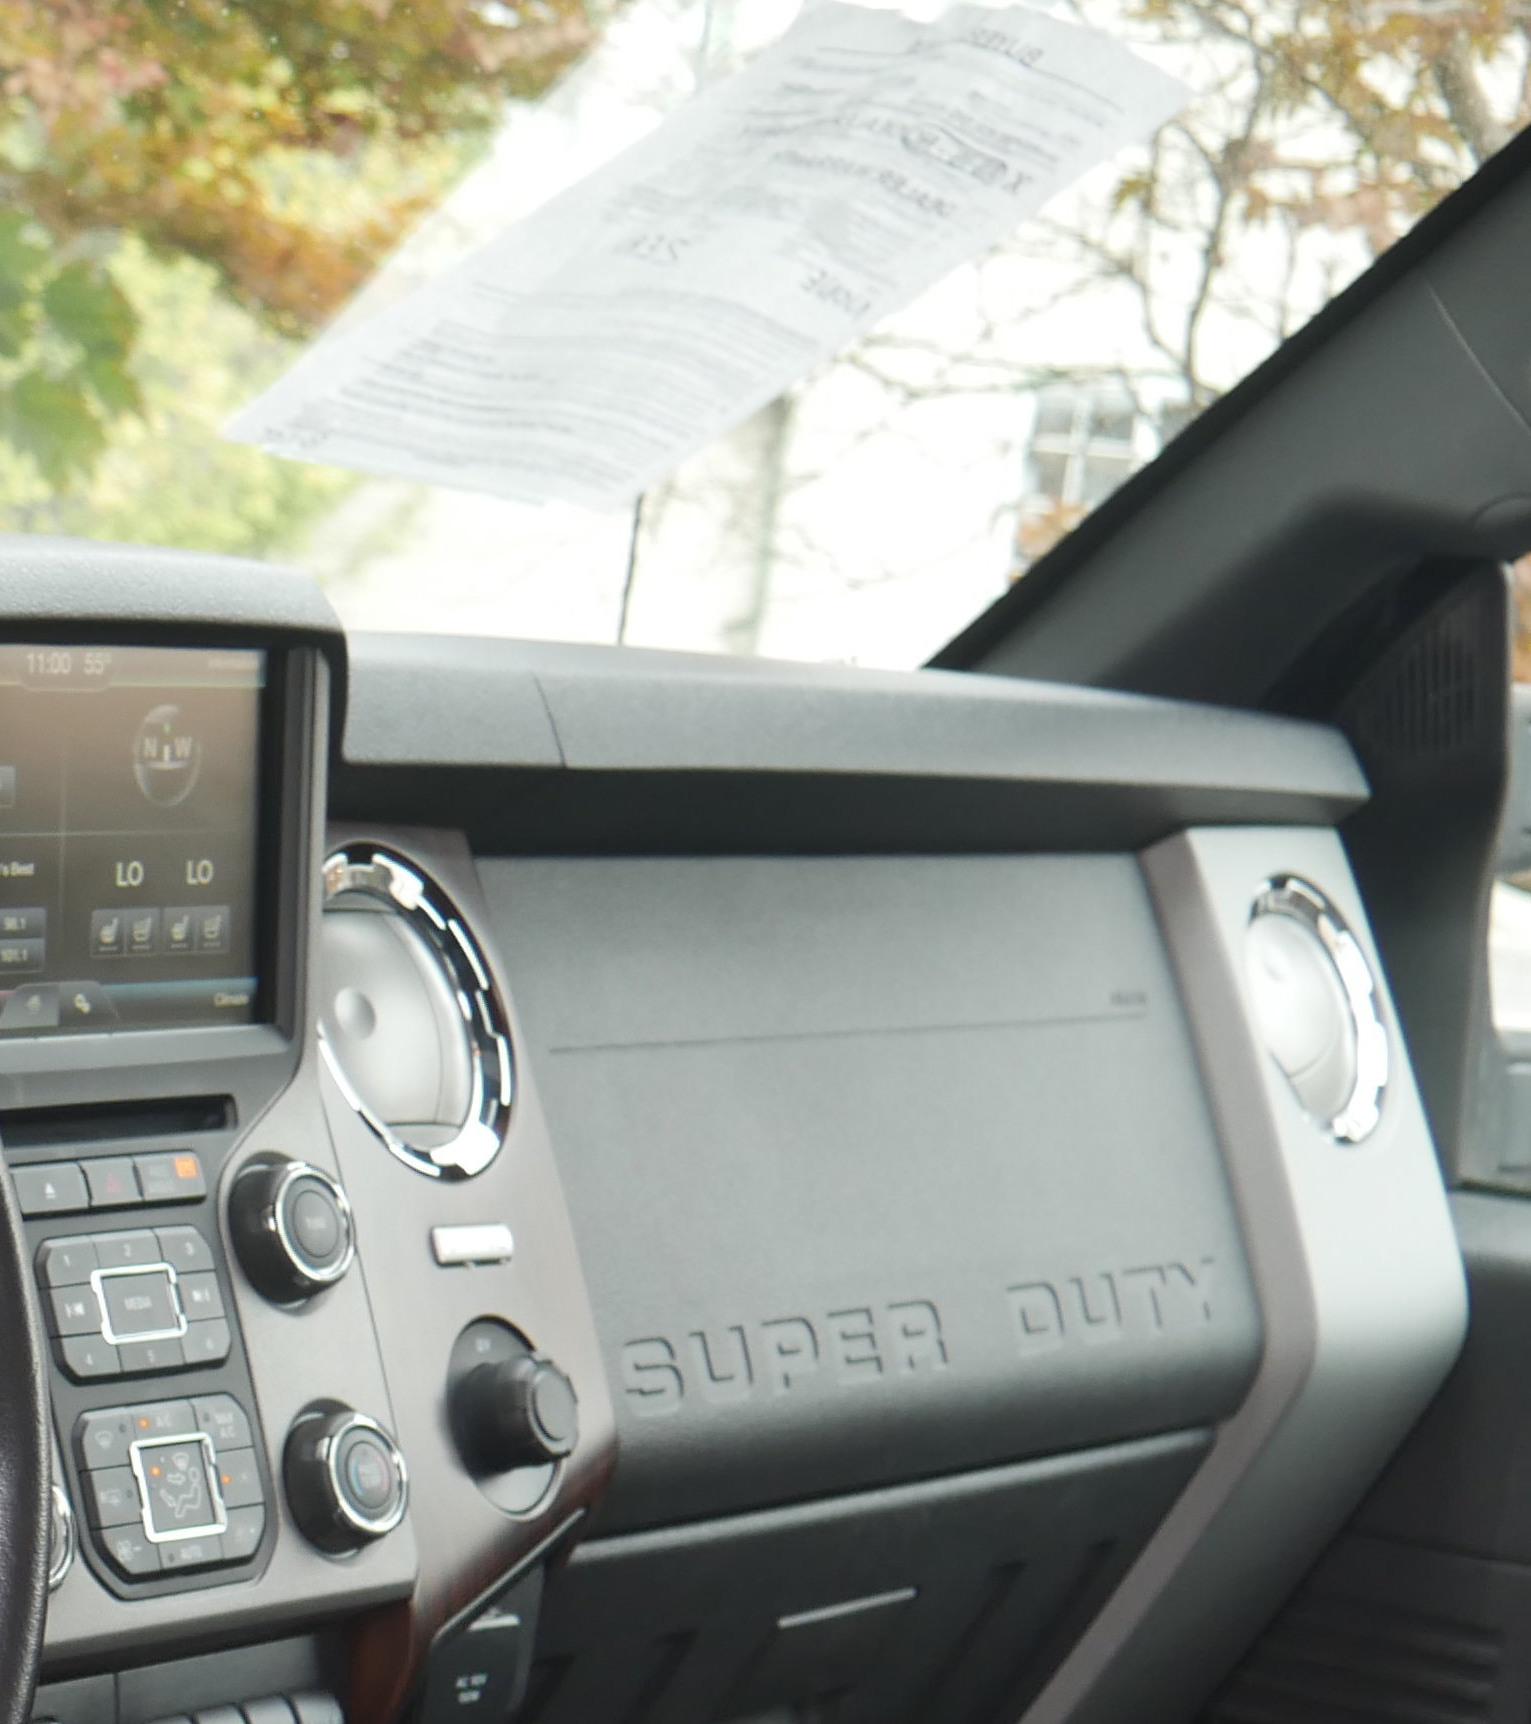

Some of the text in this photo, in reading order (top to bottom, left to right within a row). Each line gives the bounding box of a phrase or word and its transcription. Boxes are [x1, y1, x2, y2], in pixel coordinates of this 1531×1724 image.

[26, 652, 72, 676] 11:00
[115, 860, 145, 887] LO
[185, 859, 214, 886] LO
[621, 1256, 1217, 1416] SUPER DUTY
